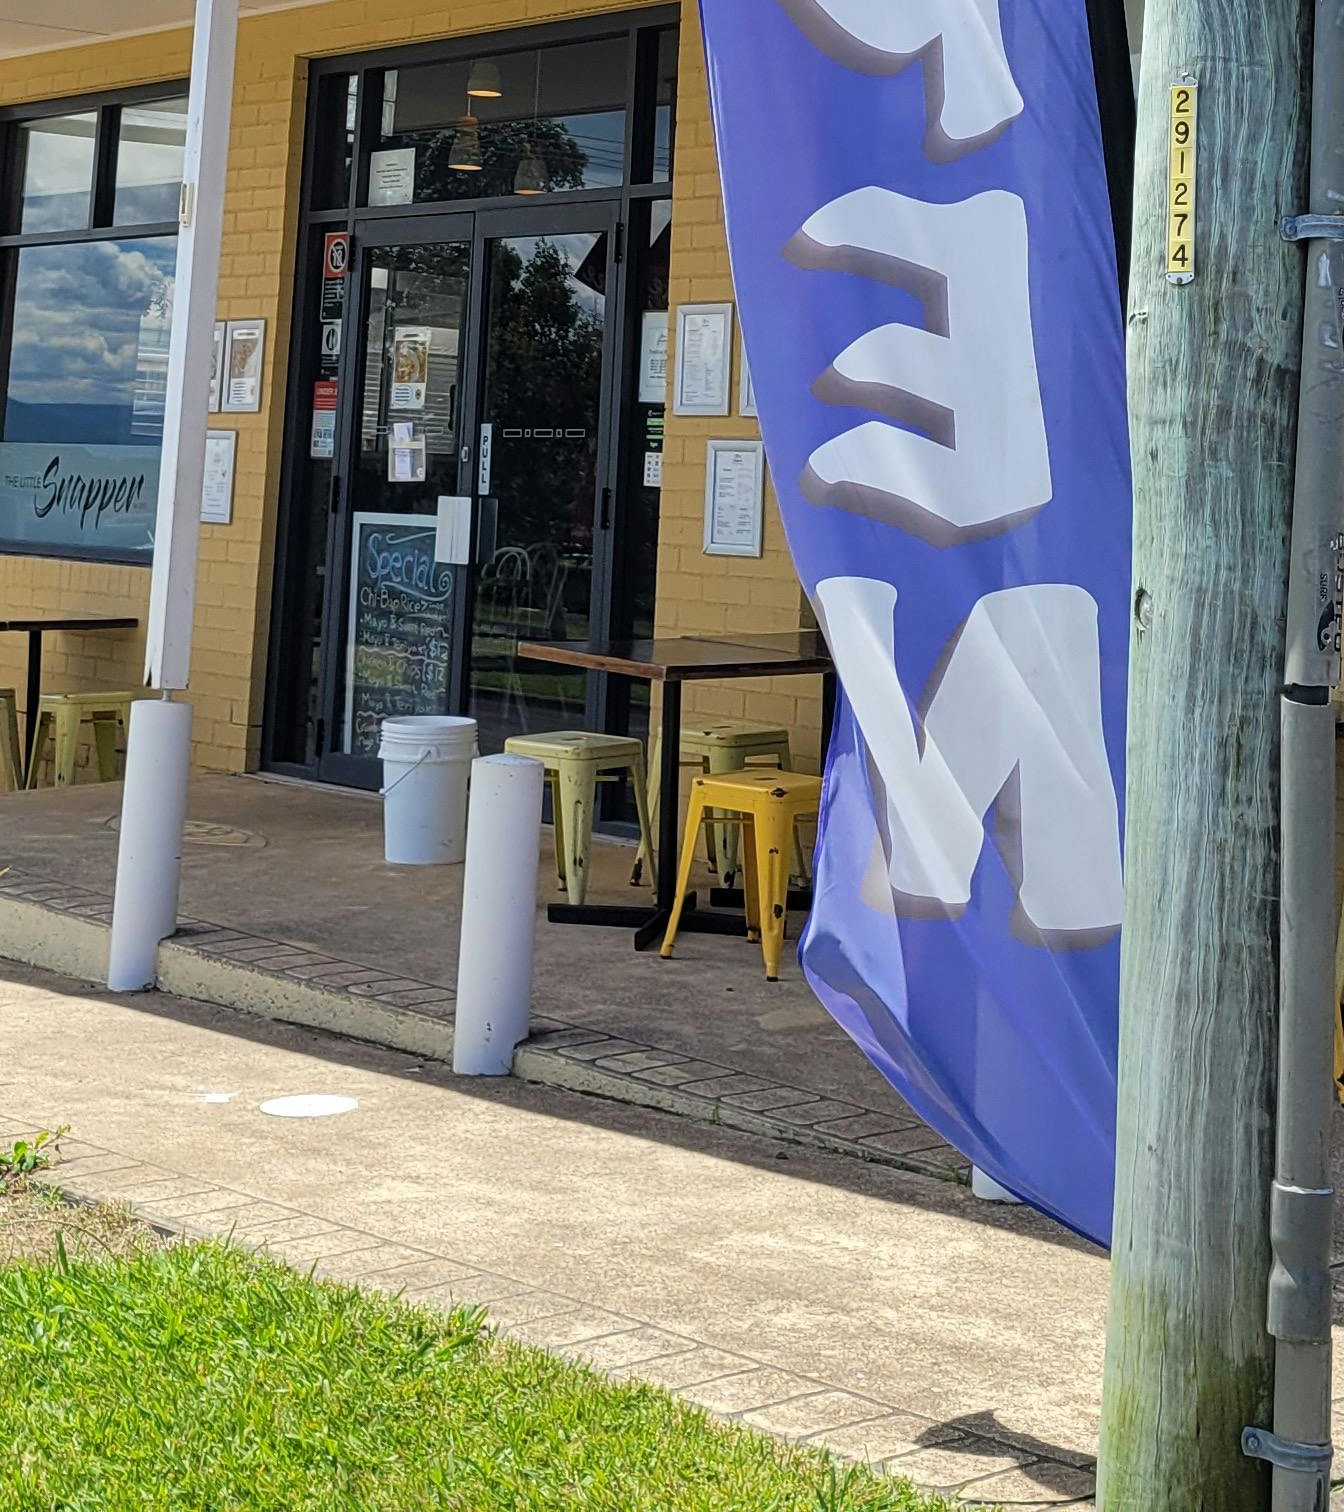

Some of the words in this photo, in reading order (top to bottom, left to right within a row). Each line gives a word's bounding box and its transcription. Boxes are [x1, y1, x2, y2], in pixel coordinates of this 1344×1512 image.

[1171, 89, 1191, 268] 291274
[4, 474, 19, 488] THE
[19, 475, 41, 489] LITTLE
[34, 455, 145, 530] Snapper
[481, 435, 489, 484] PULL
